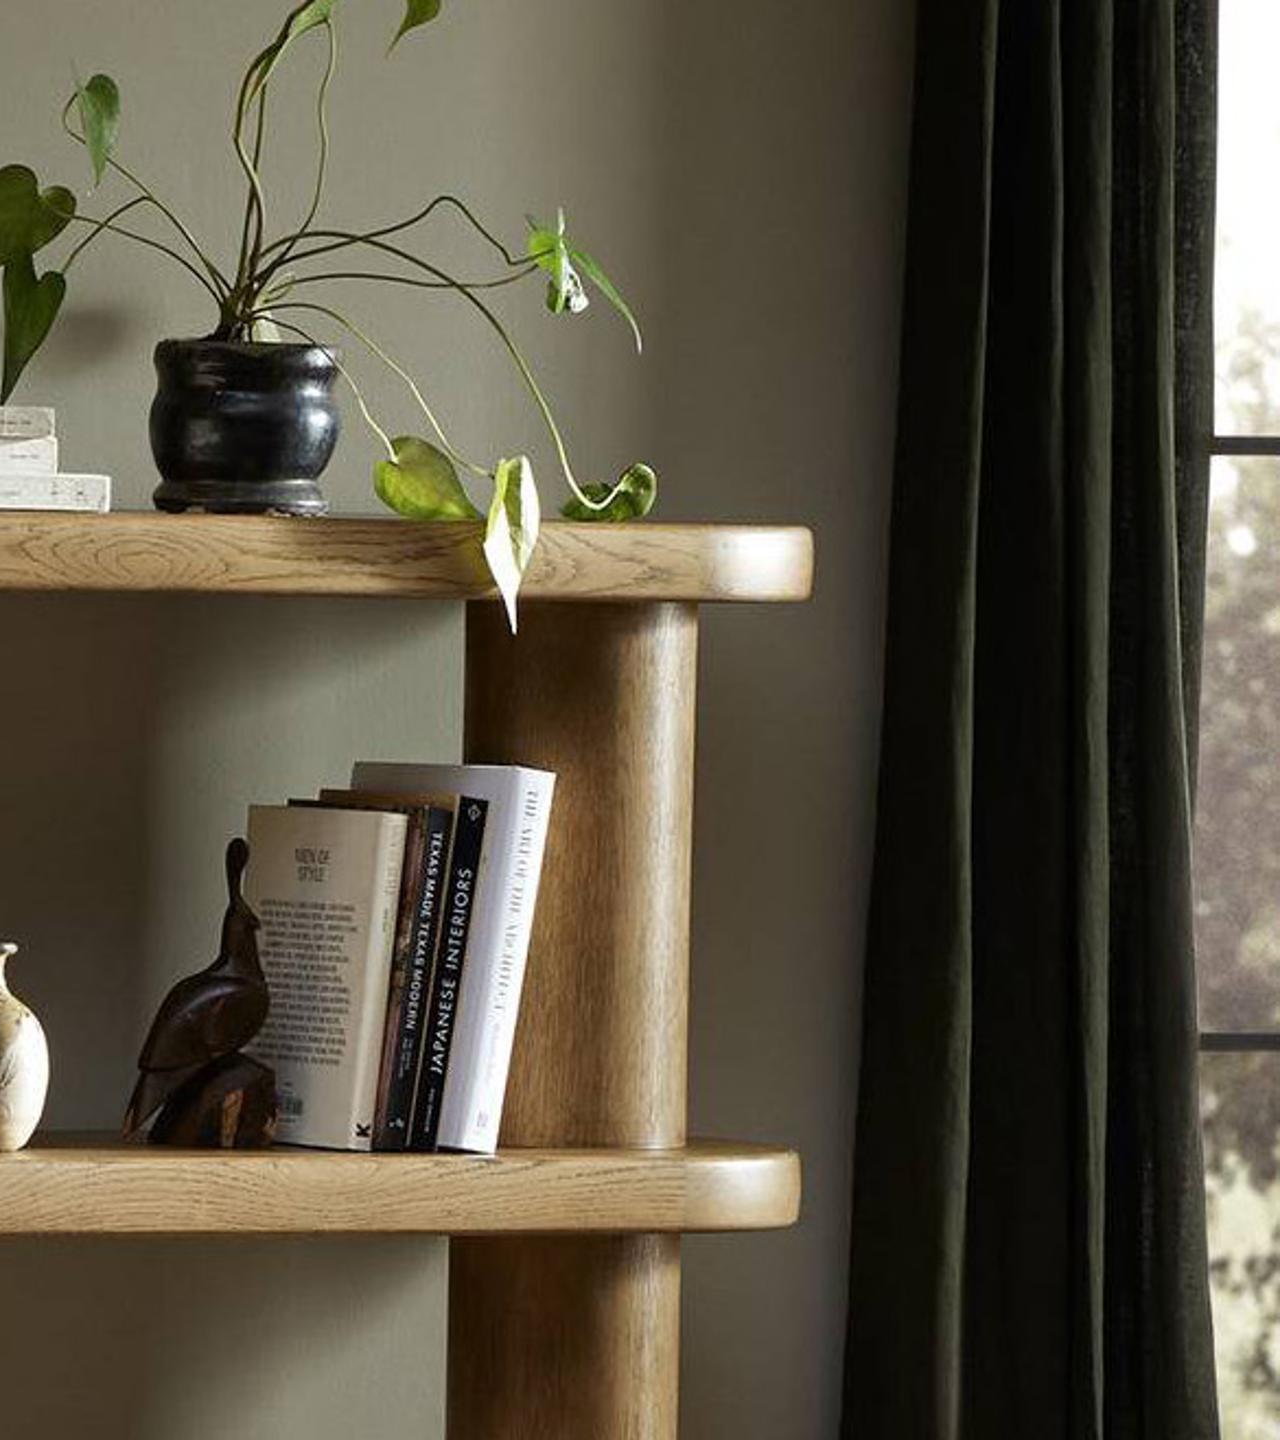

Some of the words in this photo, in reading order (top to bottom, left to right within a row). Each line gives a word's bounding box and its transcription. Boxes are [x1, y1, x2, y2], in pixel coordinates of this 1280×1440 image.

[426, 832, 444, 876] TEXAS
[419, 878, 436, 918] MADE
[413, 921, 431, 966] TEXAS
[430, 978, 457, 1076] JAPANESE
[445, 867, 472, 971] INTERIORS
[404, 968, 424, 1031] MODERN
